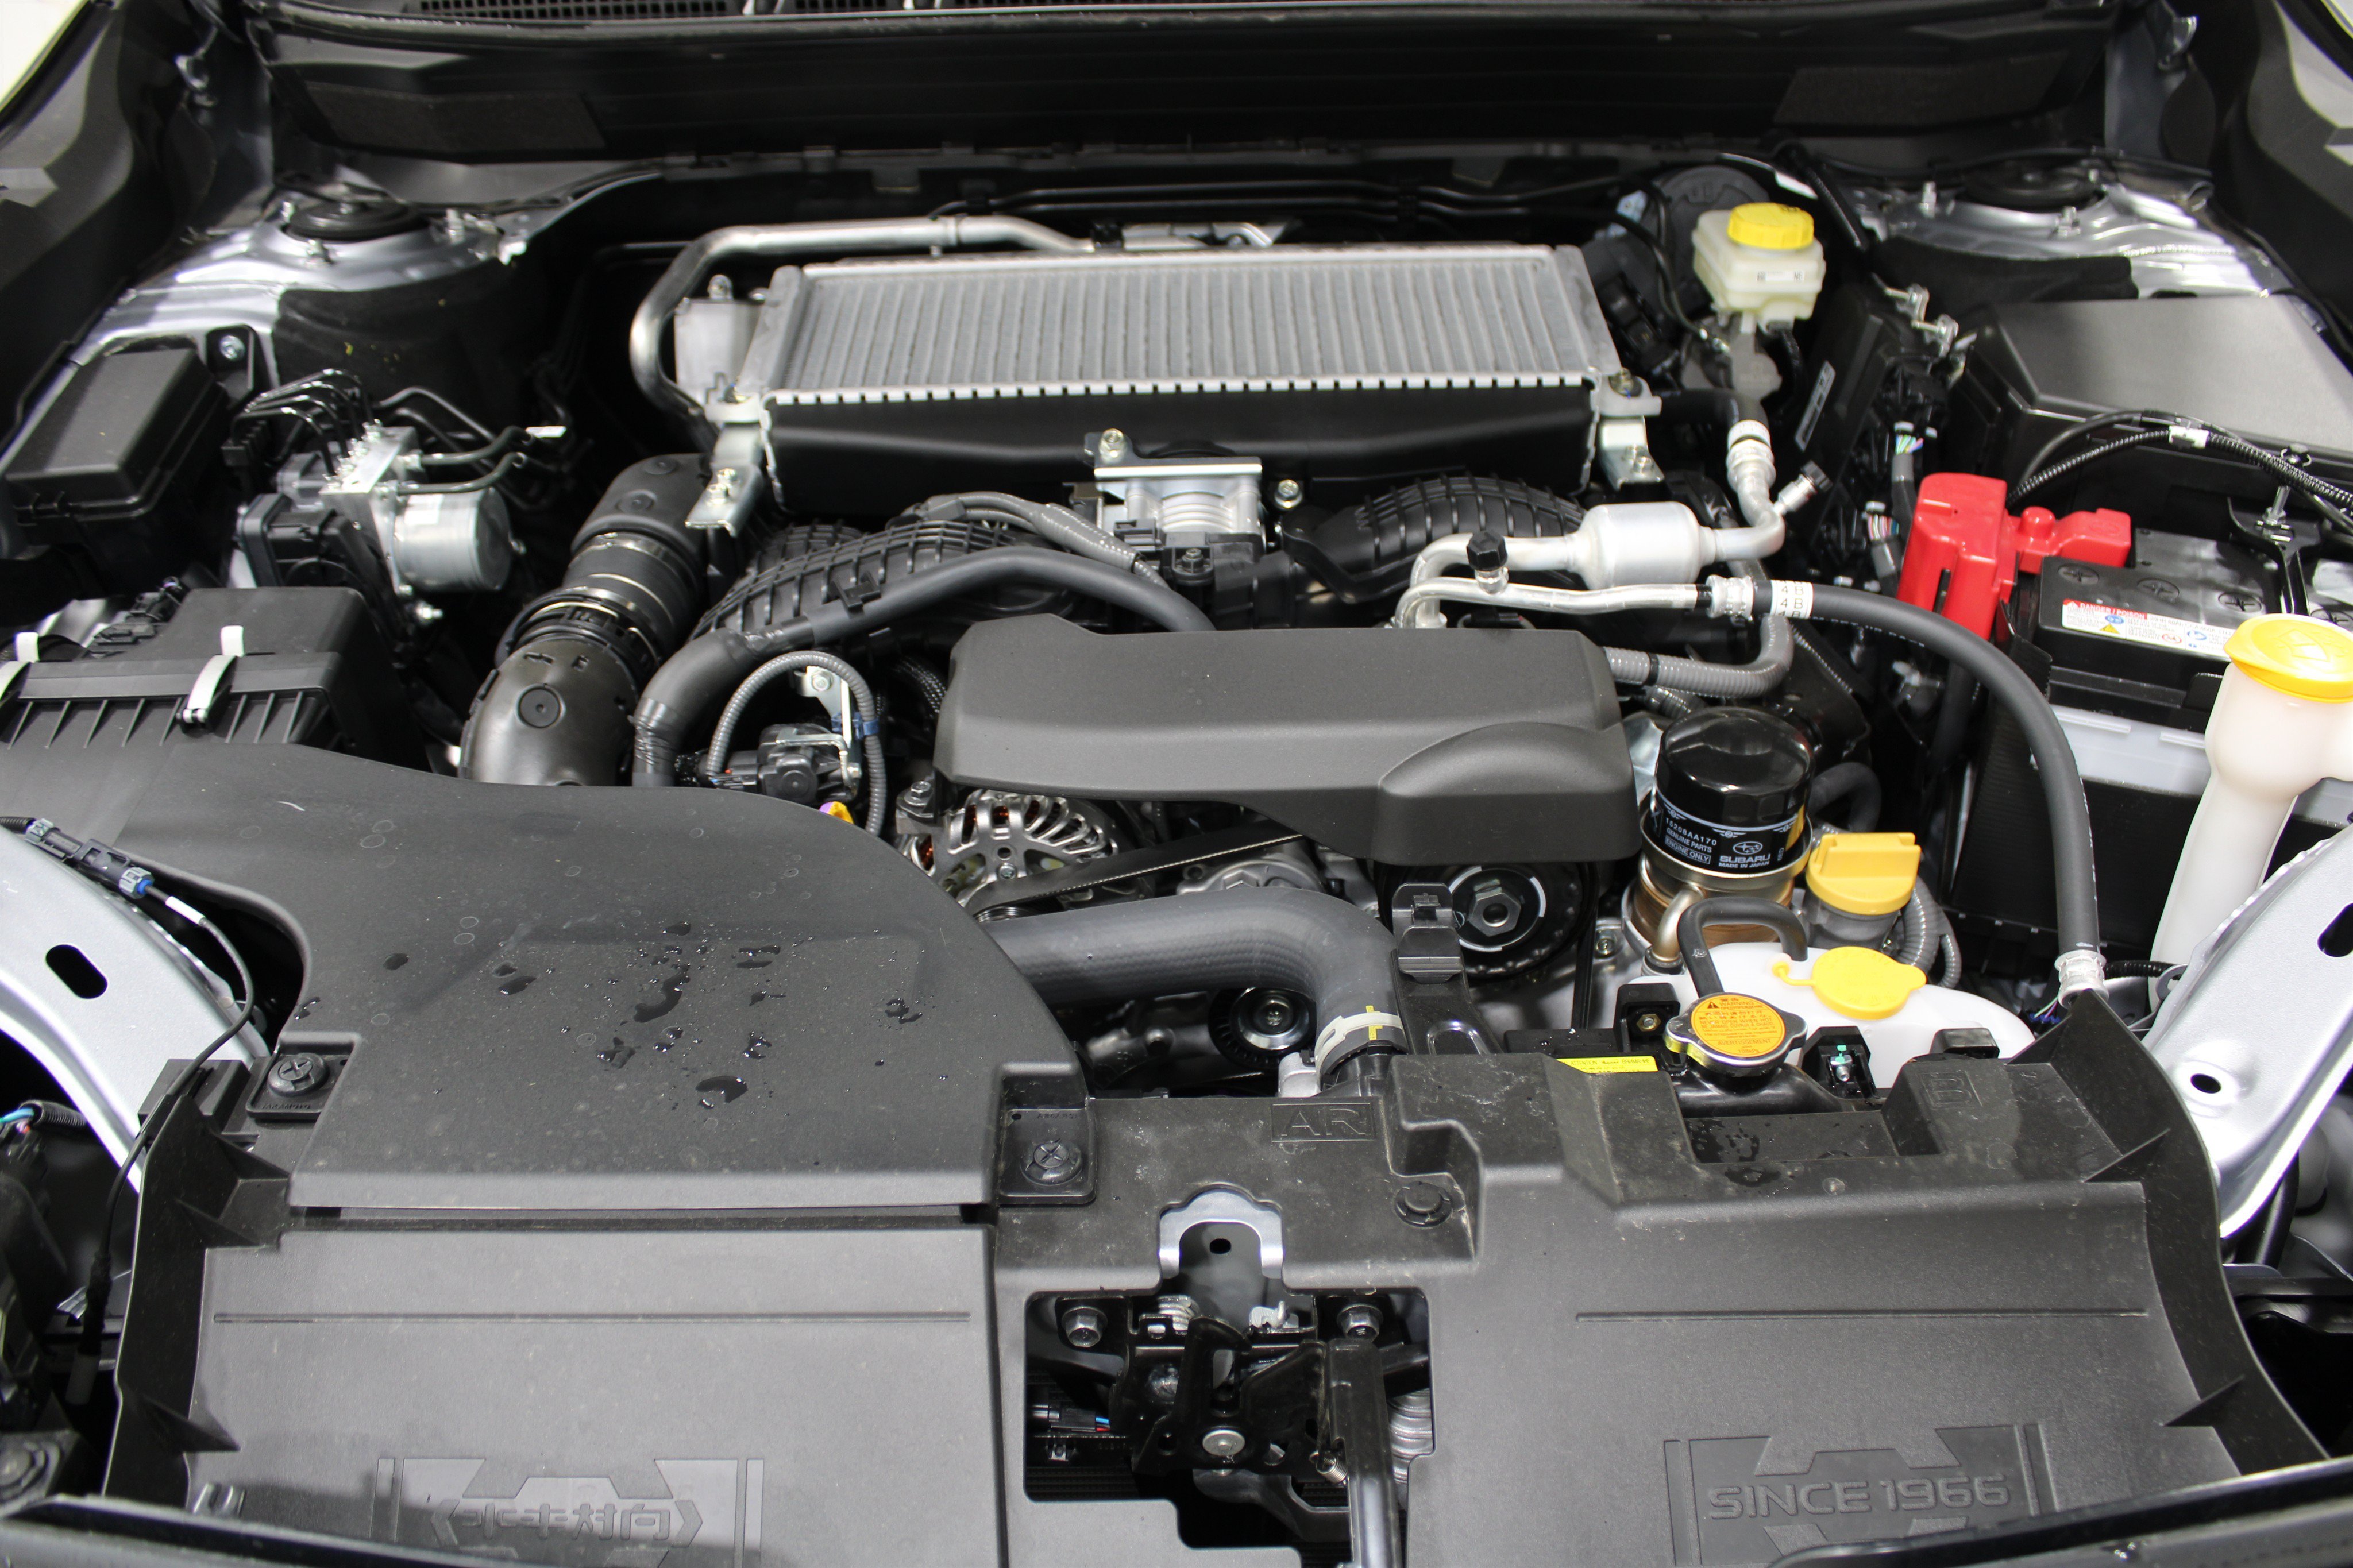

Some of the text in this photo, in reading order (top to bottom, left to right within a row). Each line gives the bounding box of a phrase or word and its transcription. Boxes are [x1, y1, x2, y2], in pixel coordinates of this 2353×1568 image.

[1780, 598, 1803, 609] 4 B
[1795, 586, 1804, 596] B
[2080, 602, 2111, 615] DANGER
[2116, 608, 2145, 620] POISON
[1665, 817, 1717, 846] 15208AA170
[1667, 828, 1712, 853] GENUINE PARTS
[1667, 837, 1710, 862] ENGINE ONLY
[1719, 854, 1770, 863] SUBARU
[1280, 1107, 1366, 1137] AR
[1708, 1474, 2011, 1520] SINCE 1966
